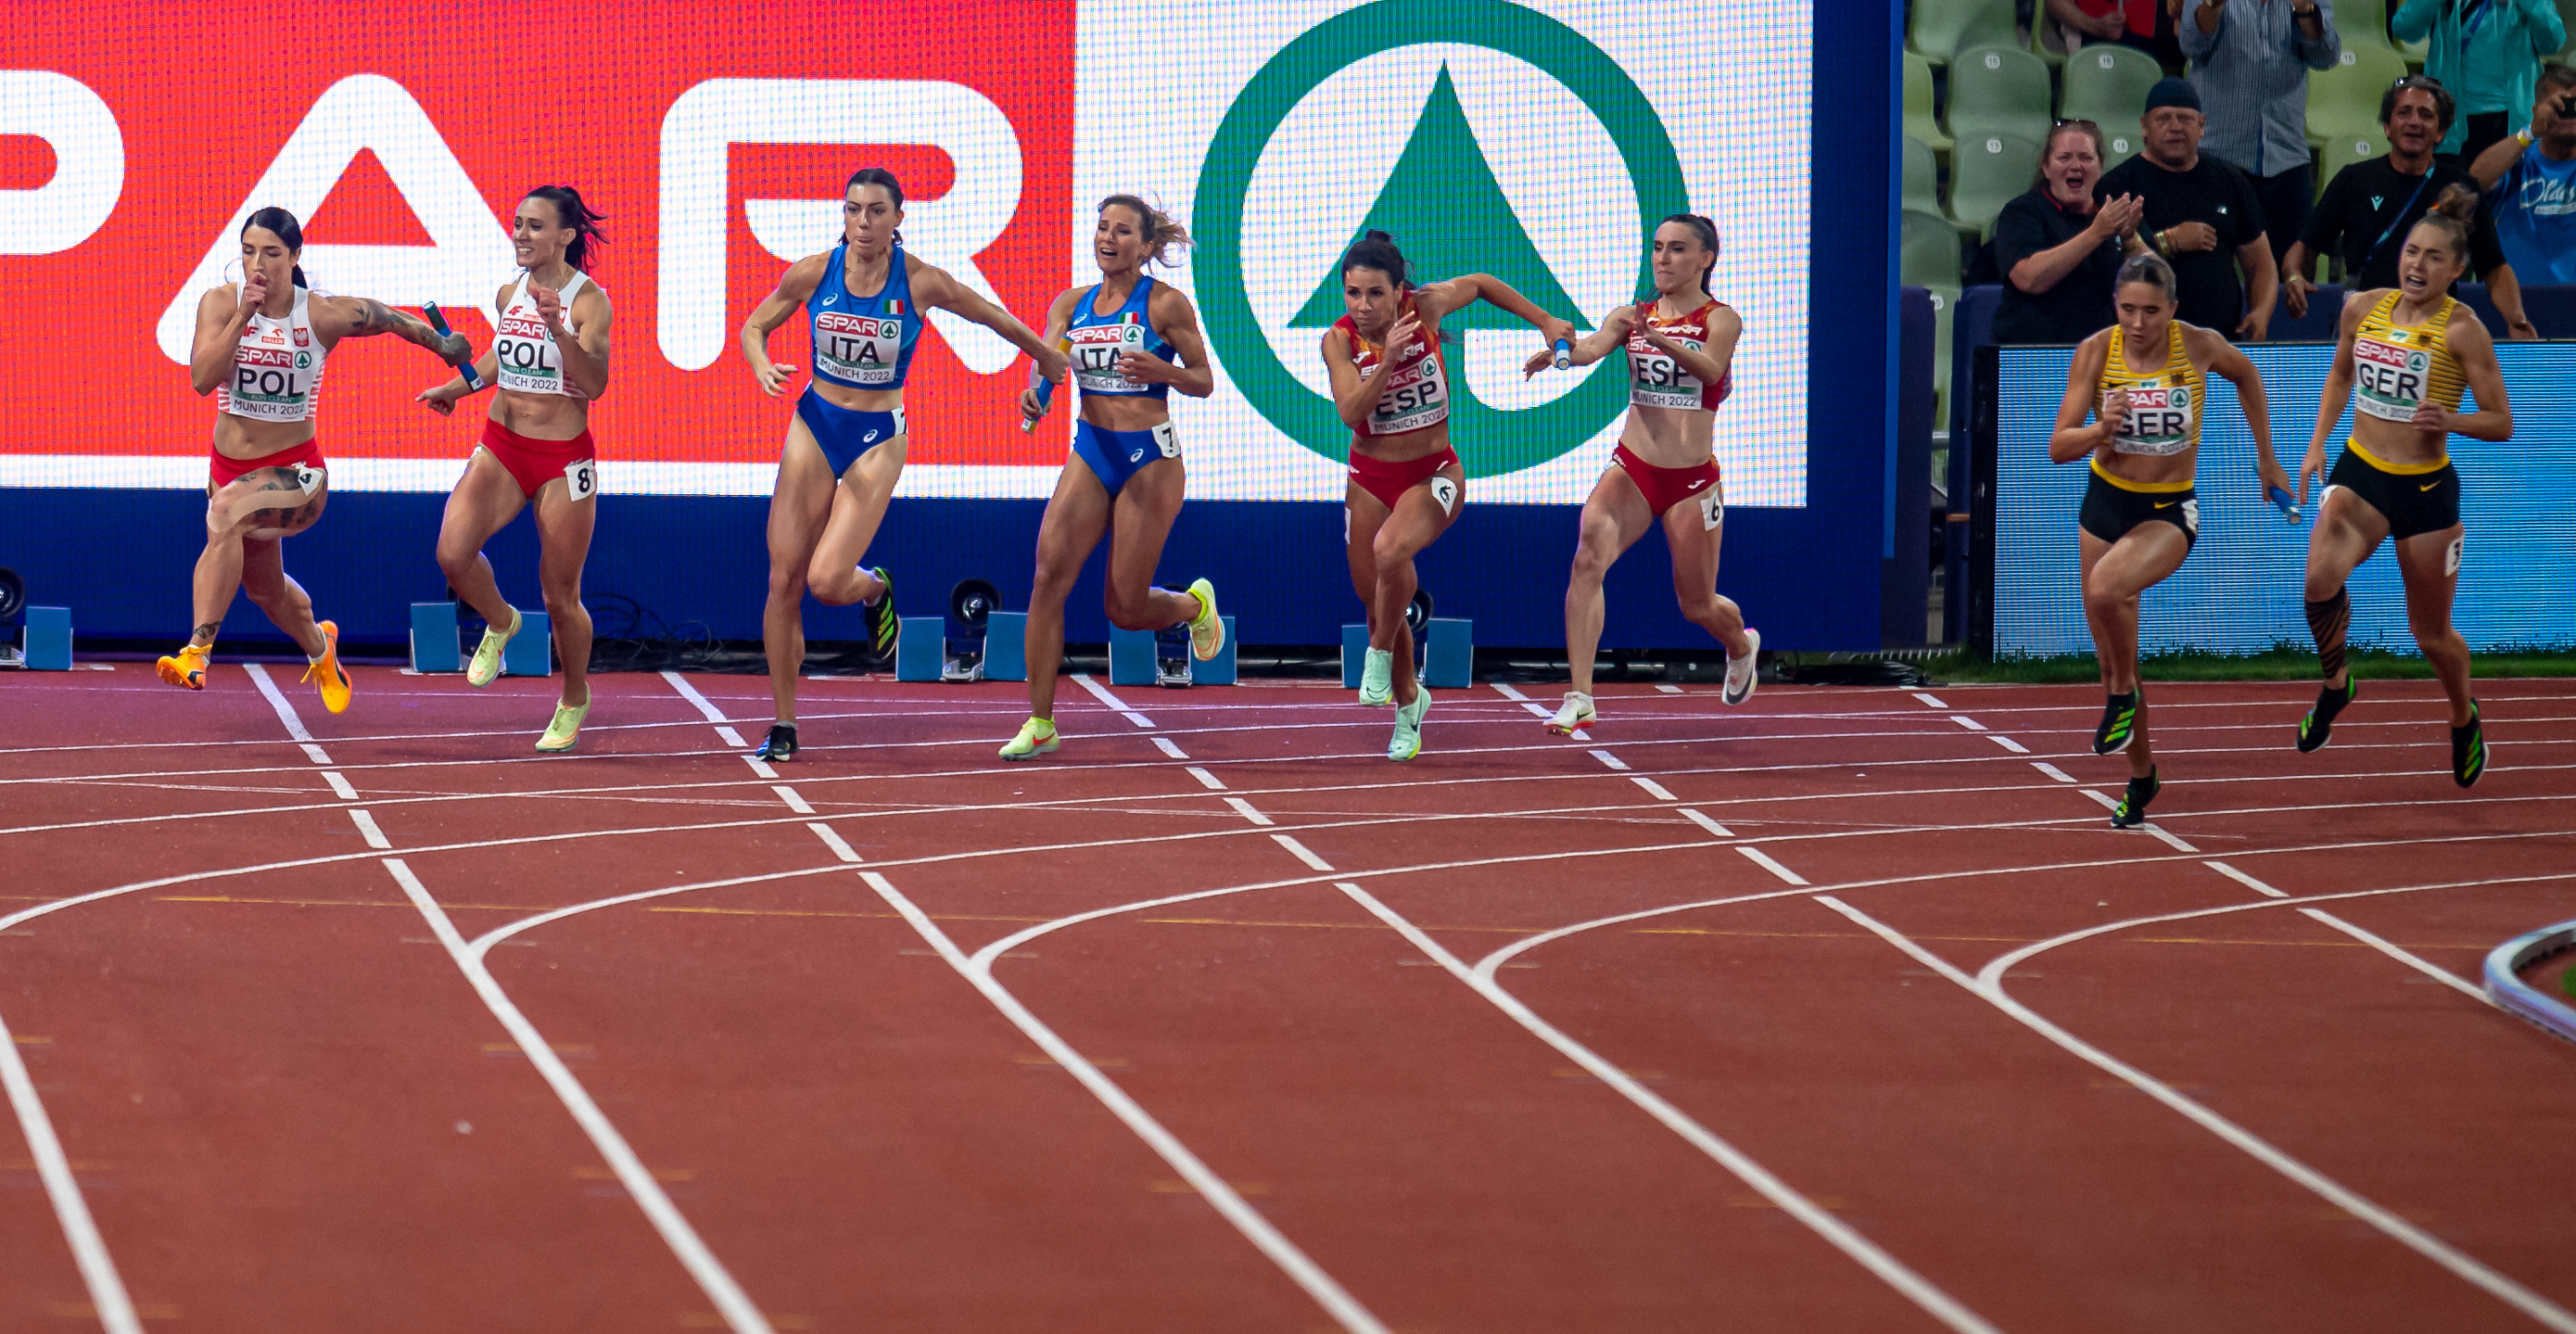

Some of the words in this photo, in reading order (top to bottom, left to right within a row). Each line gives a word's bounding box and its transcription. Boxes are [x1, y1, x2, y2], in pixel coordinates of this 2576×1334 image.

[501, 321, 545, 337] SPAR
[818, 315, 876, 335] SPAR
[1071, 328, 1121, 342] SPAR
[262, 337, 284, 345] ORLEN
[831, 336, 881, 363] ITA
[235, 349, 291, 365] SPAR
[499, 339, 555, 372] POL
[2355, 341, 2407, 366] SPAR
[820, 358, 860, 379] MUNICH
[862, 371, 890, 381] 2022
[2359, 362, 2420, 400] GER
[238, 367, 305, 397] POL
[531, 378, 558, 390] 2022
[234, 400, 276, 413] MUNICH
[280, 403, 306, 415] 2022
[1375, 380, 1438, 416] ESP
[1669, 396, 1696, 407] 2022
[2107, 391, 2167, 406] PAR
[1374, 418, 1418, 433] MUNICH
[1421, 409, 1446, 423] 2022
[1161, 426, 1174, 453] 7
[577, 467, 590, 493] 8
